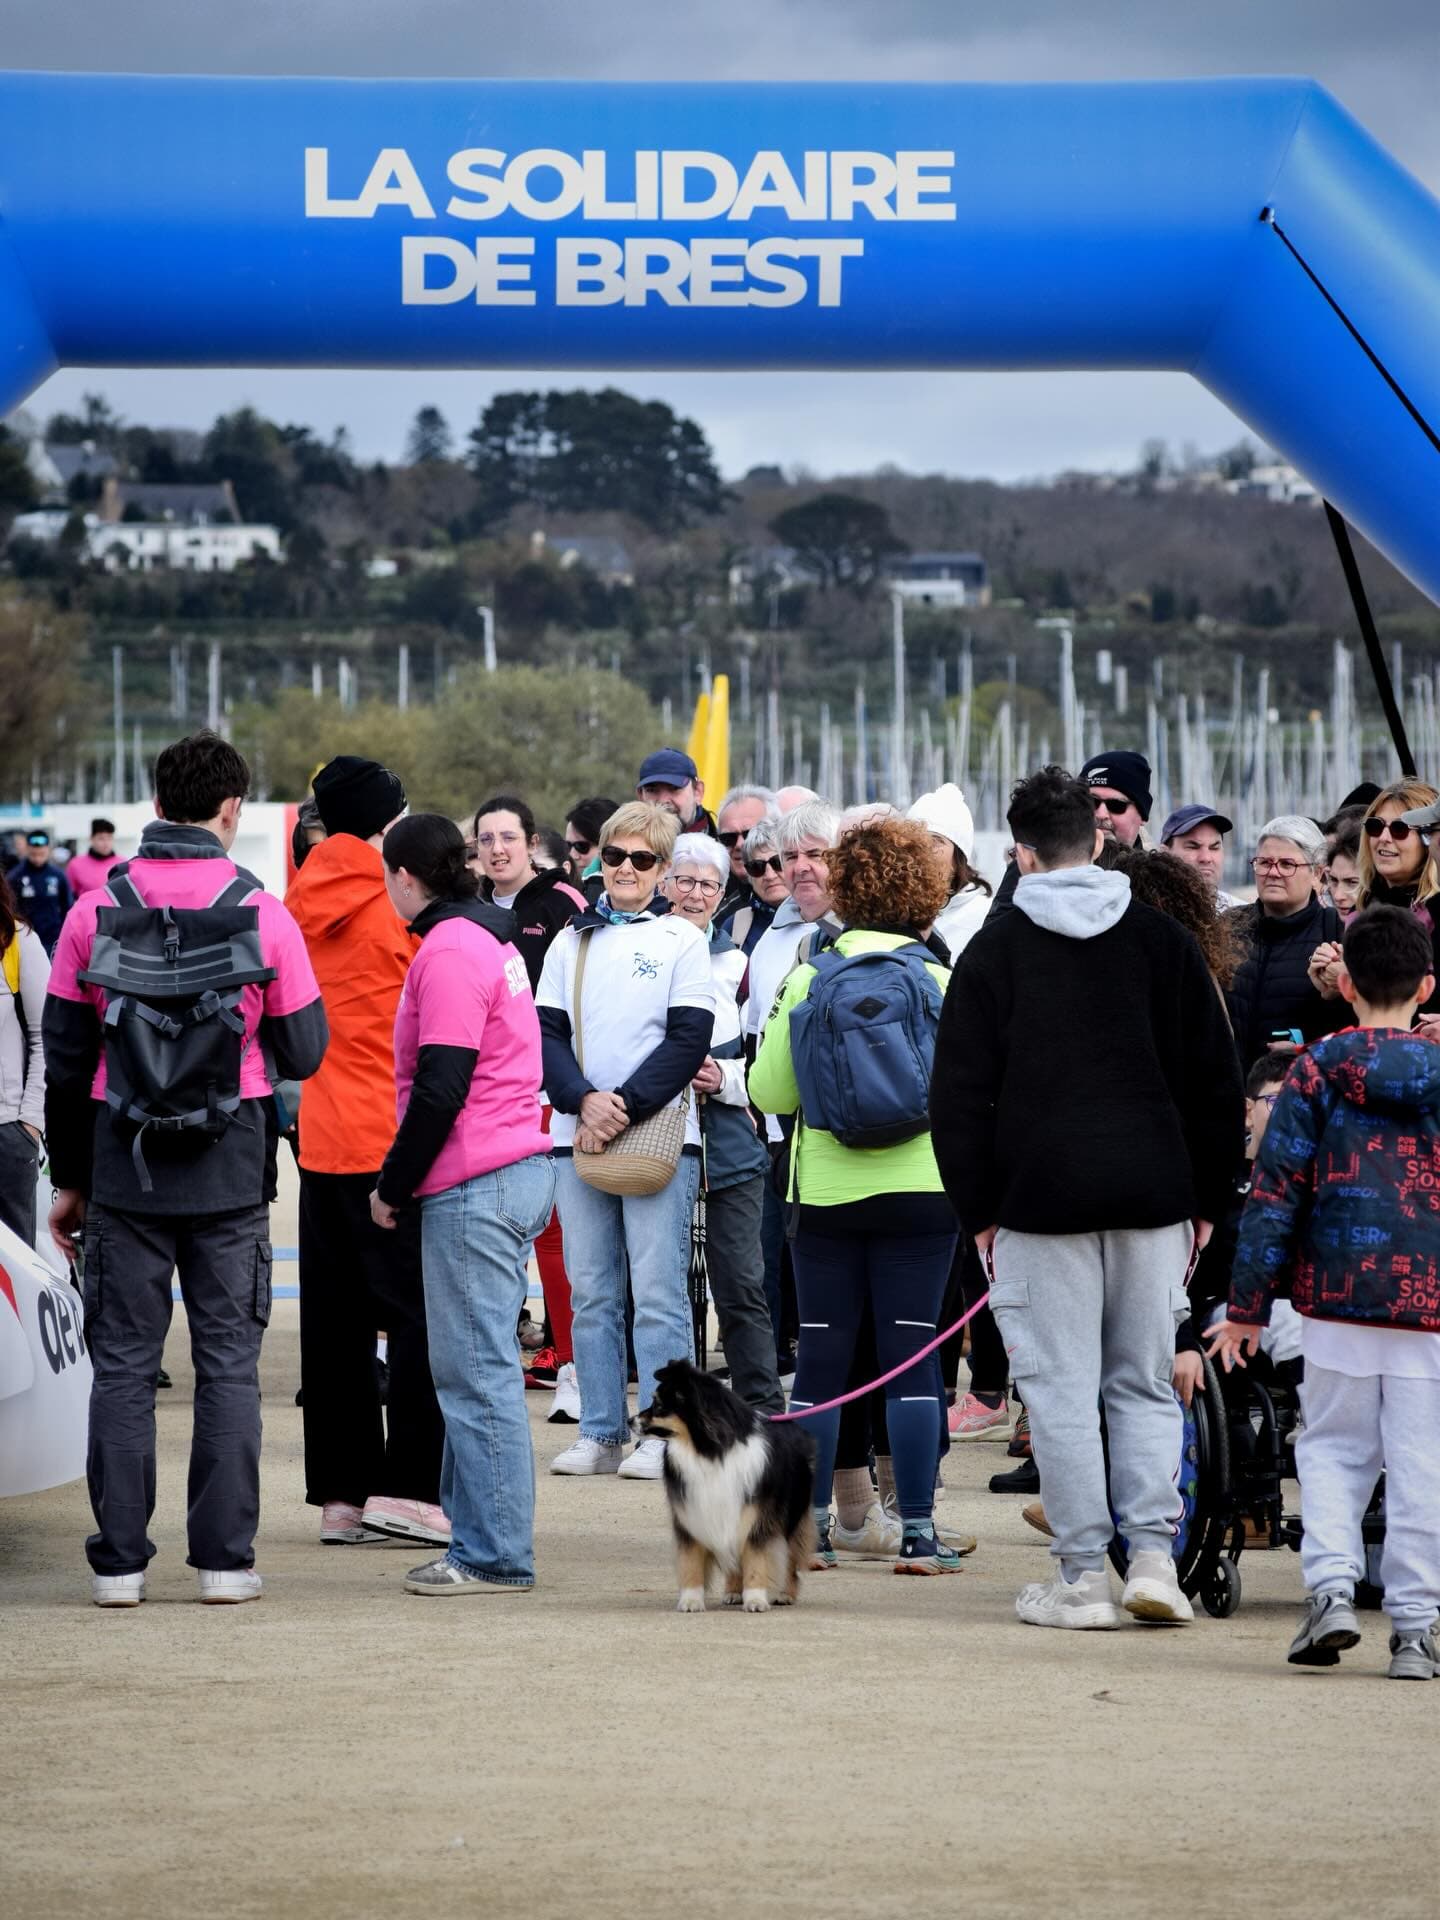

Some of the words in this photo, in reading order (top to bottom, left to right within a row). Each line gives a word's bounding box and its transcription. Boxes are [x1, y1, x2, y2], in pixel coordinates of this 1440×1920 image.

[304, 147, 437, 219] LA
[445, 148, 957, 221] SOLIDAIRE
[401, 236, 536, 306] DE
[555, 237, 864, 308] BREST
[522, 927, 543, 936] PUMA
